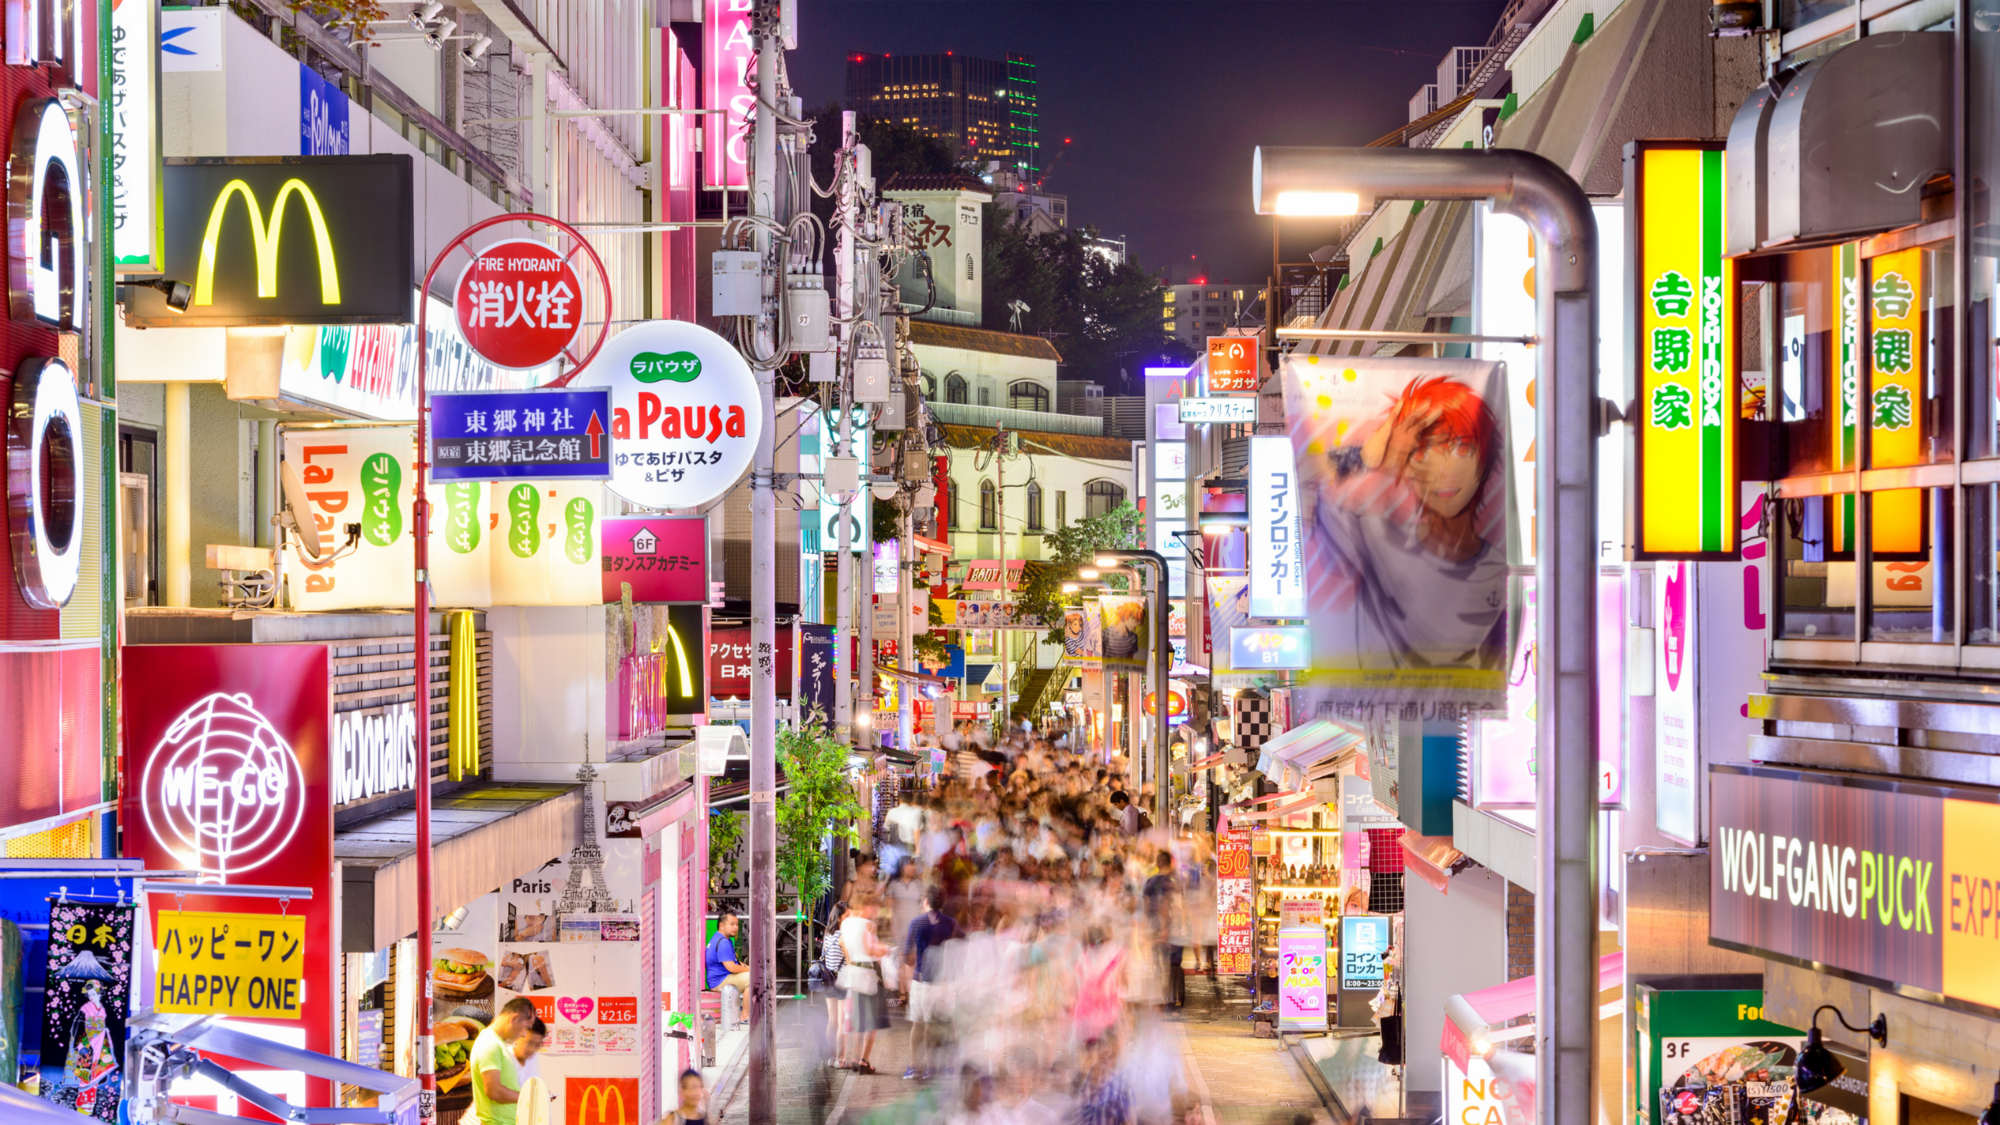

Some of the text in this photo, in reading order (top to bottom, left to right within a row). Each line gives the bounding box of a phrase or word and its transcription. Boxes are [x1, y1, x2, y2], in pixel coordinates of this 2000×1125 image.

[478, 258, 562, 272] FIRE HYDRANT
[468, 280, 574, 329] 消火栓
[1212, 343, 1225, 351] 2F
[633, 360, 699, 374] ラパウザ
[1220, 378, 1256, 389] アガサ
[464, 408, 575, 434] 東郷神社
[638, 391, 746, 444] Pausa
[438, 438, 581, 464] 原宿 東郷記念館
[614, 450, 723, 466] ゆであげパスタ
[645, 468, 686, 483] &ピザ
[372, 457, 391, 544] ラパウザ
[517, 486, 533, 557] ラパウザ
[573, 499, 586, 563] ラパウザ
[1271, 473, 1288, 595] コインロッカー
[636, 539, 653, 550] 6F
[601, 555, 700, 572] 宿ダンスアカデミー
[571, 847, 602, 858] French
[1218, 850, 1249, 874] 50
[512, 878, 551, 894] Paris
[66, 923, 116, 949] 日本
[162, 924, 299, 963] ハッピーワン
[1221, 936, 1250, 945] SALE
[1219, 953, 1251, 972] 半額
[1282, 952, 1322, 966] プリクラ
[1346, 953, 1376, 963] コイン
[1290, 967, 1315, 975] SHOP
[1283, 976, 1322, 988] NOA
[160, 973, 297, 1010] HAPPY ONE
[600, 1010, 636, 1022] ¥216-
